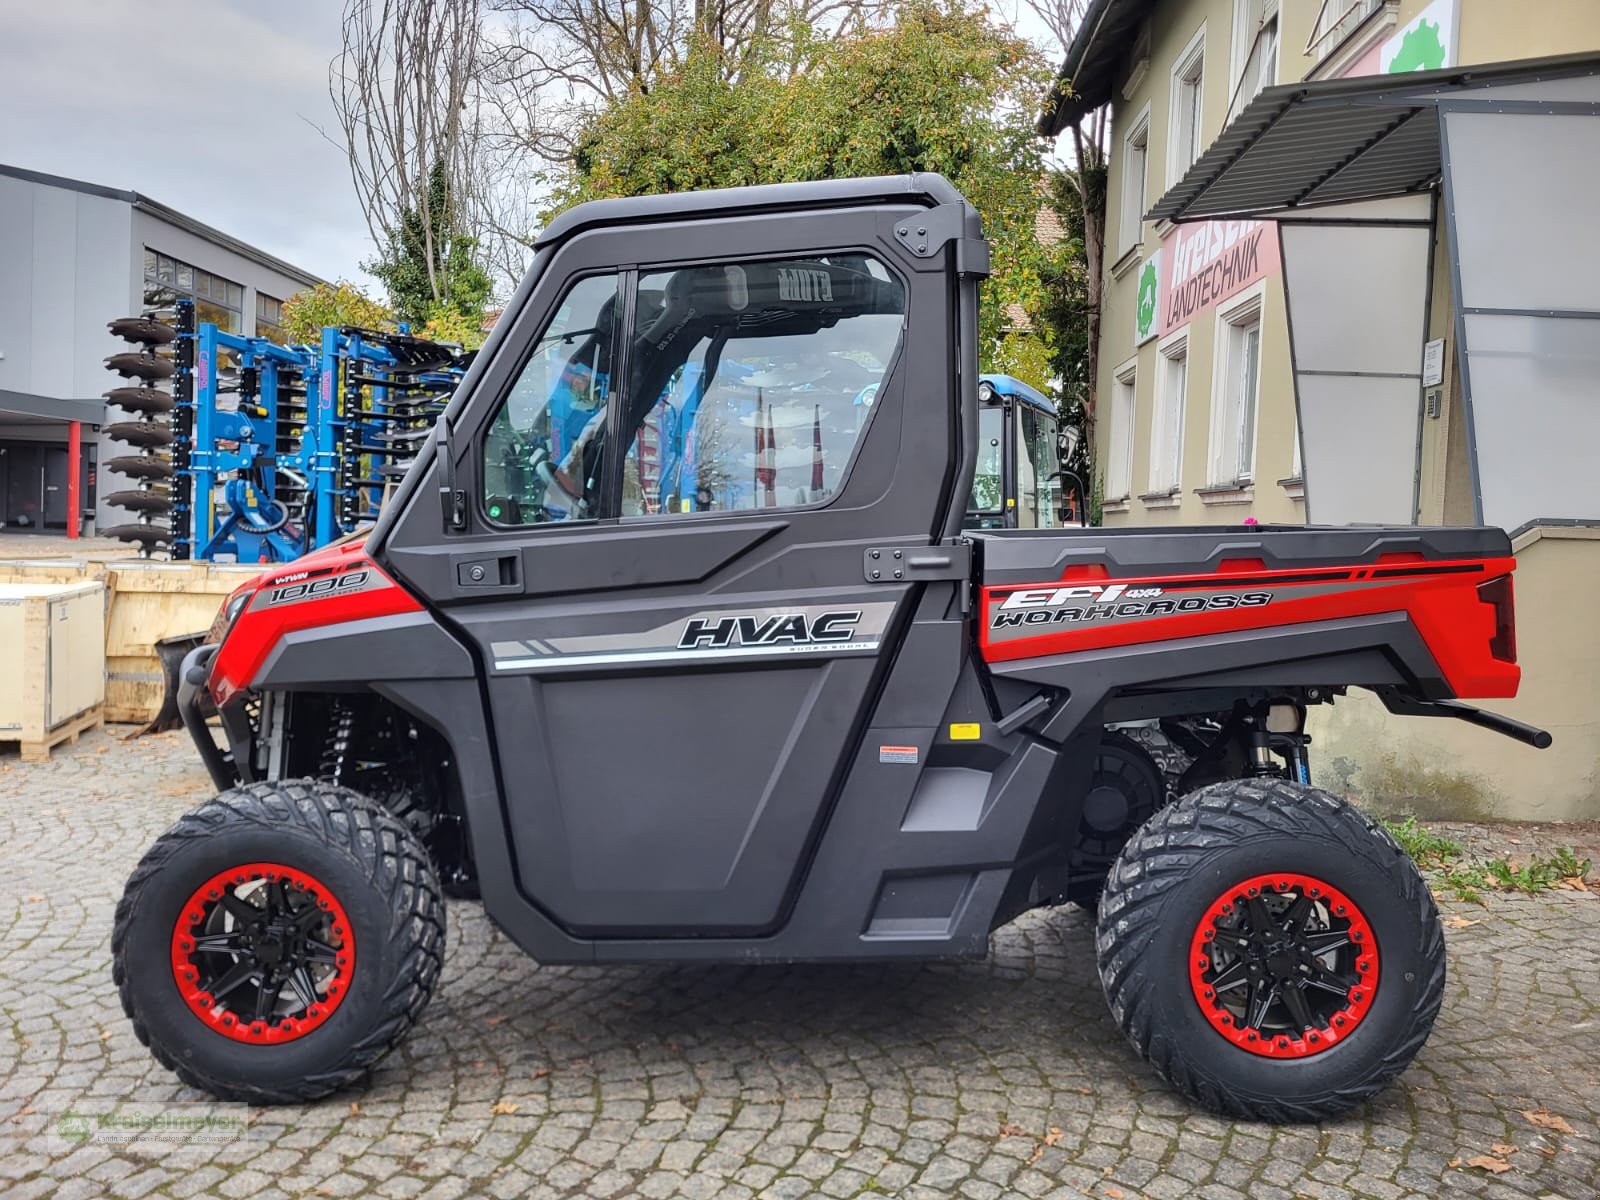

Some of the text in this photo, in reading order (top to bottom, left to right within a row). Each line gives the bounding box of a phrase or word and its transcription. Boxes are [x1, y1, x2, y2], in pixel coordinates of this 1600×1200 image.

[1166, 228, 1264, 329] LANDTECHNIK
[269, 570, 370, 604] 1000
[998, 584, 1128, 610] EFI
[989, 592, 1273, 629] WORKCROSS
[677, 610, 863, 649] HVAC
